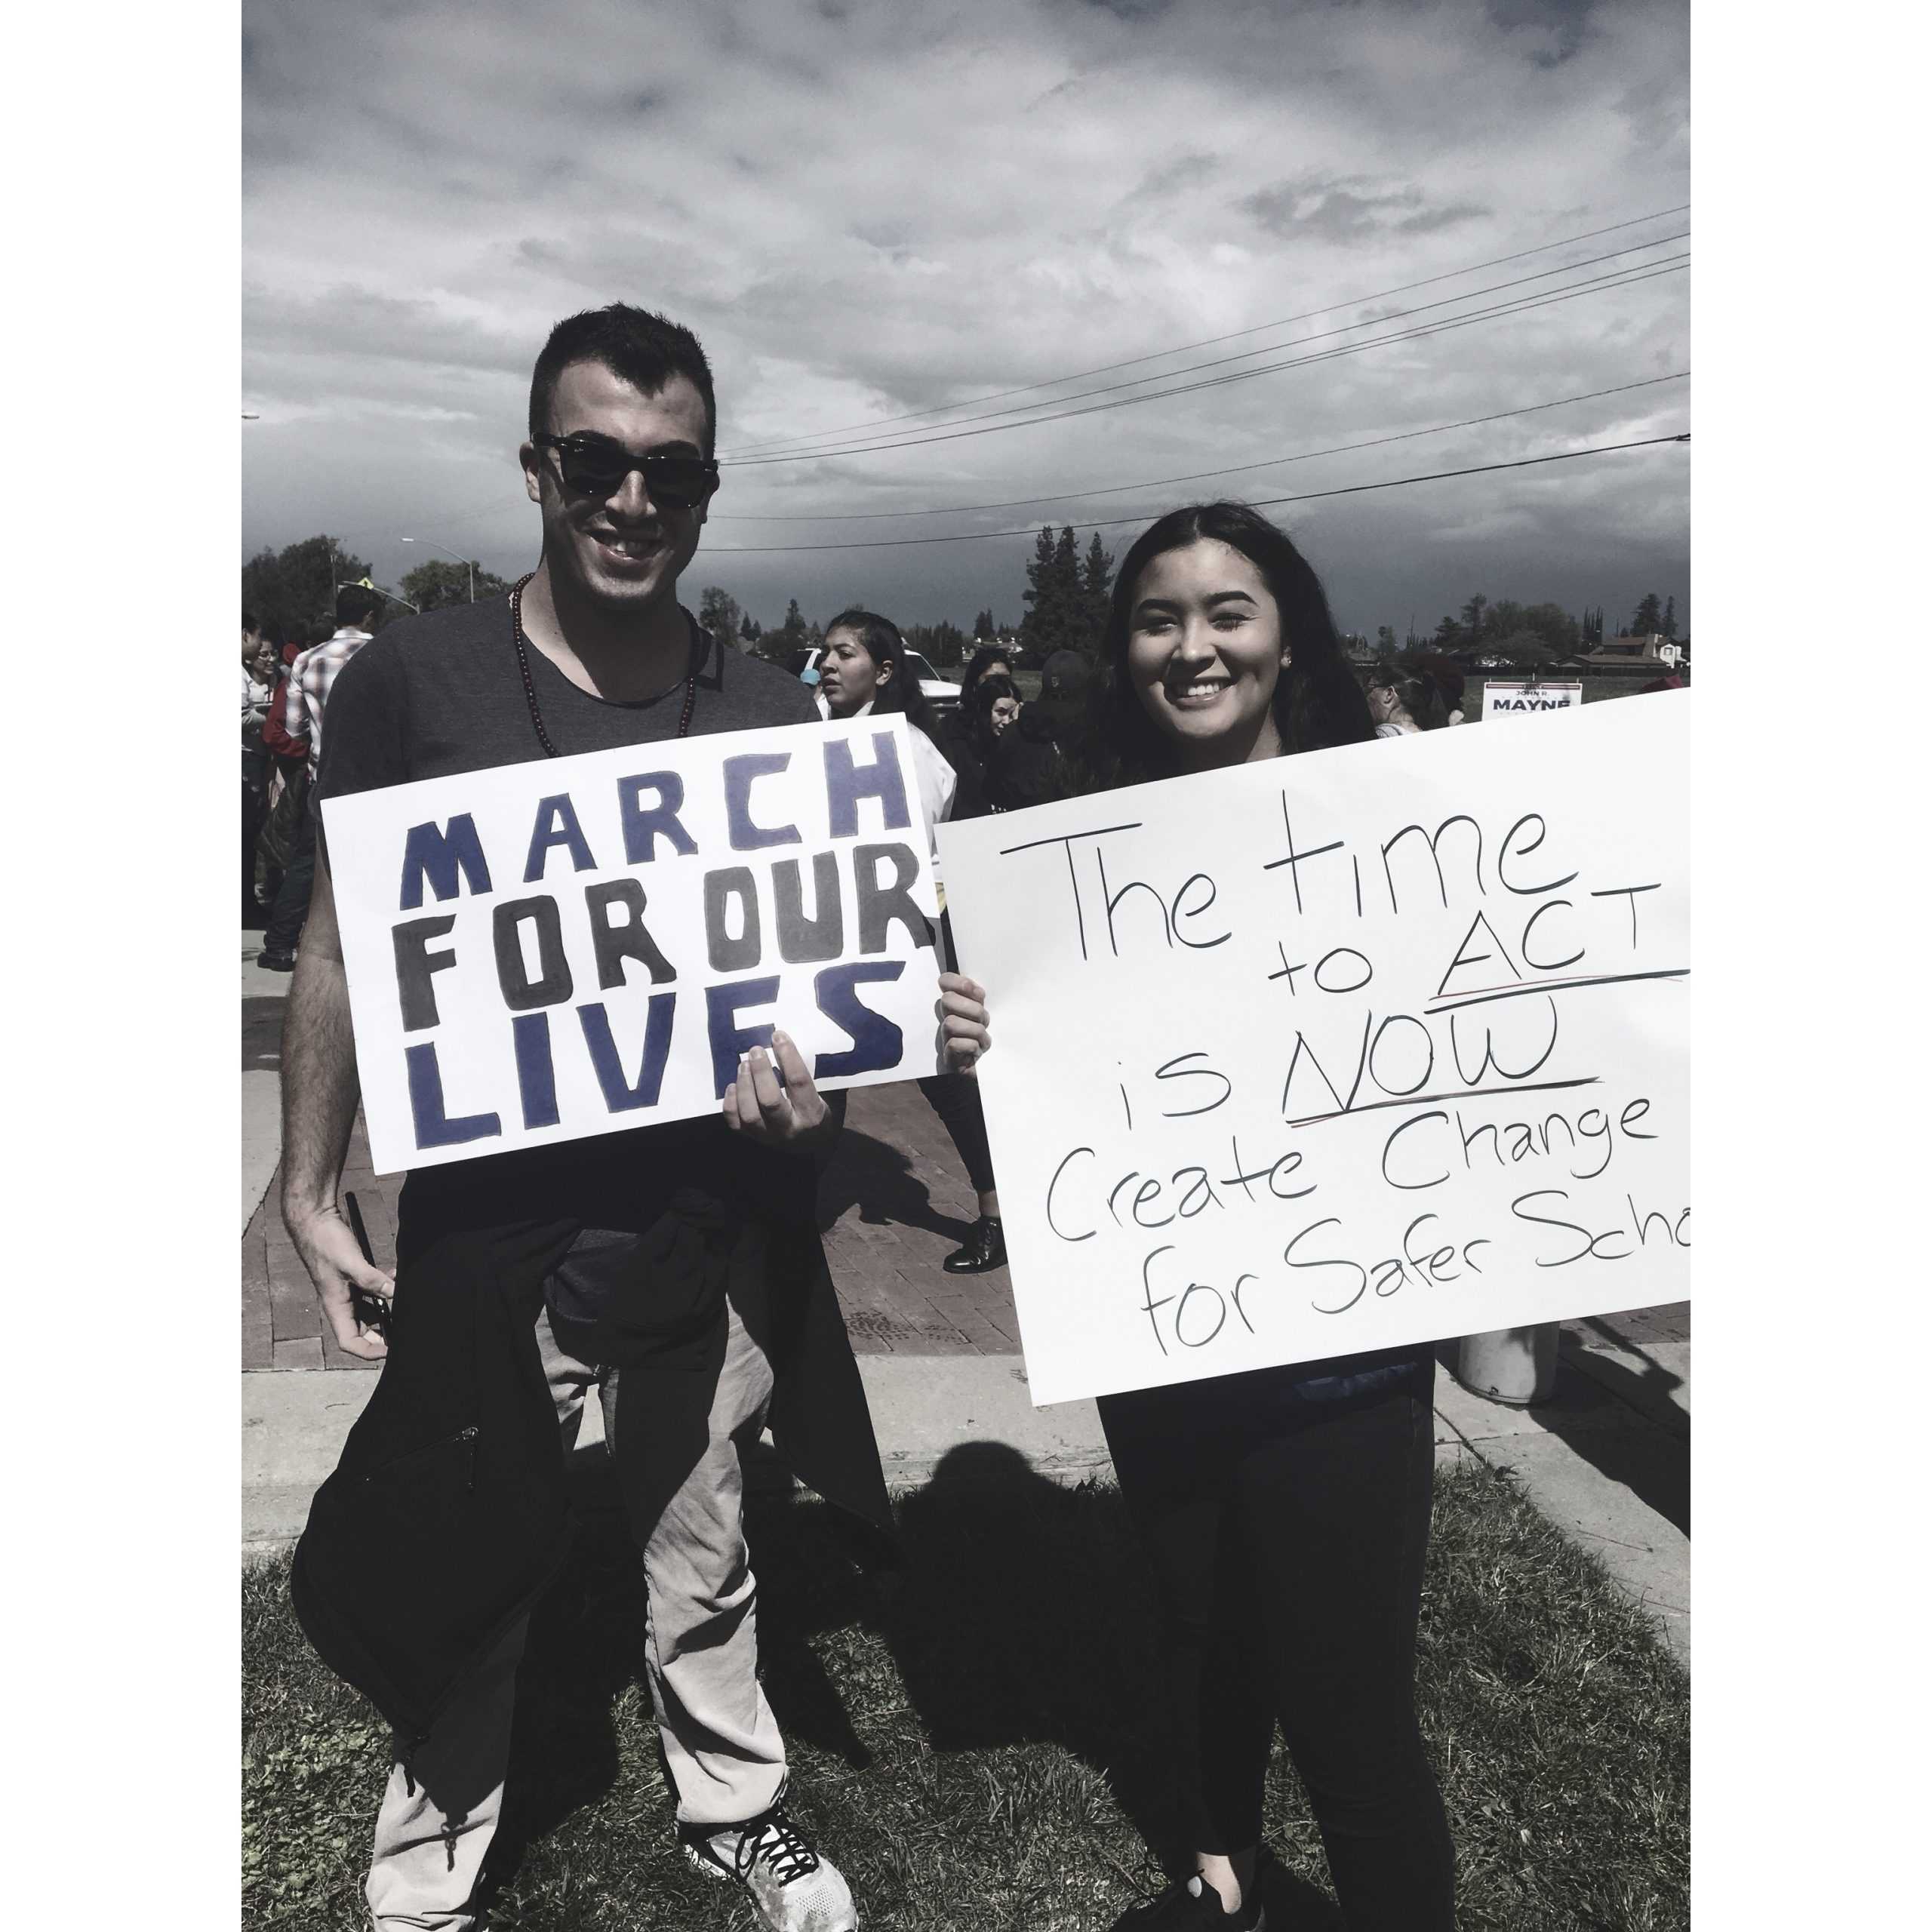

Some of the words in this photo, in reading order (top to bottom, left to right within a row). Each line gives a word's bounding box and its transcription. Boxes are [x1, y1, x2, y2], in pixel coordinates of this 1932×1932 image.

[400, 732, 911, 911] MARCH
[1000, 823, 1232, 961] The
[1263, 789, 1579, 917] time
[392, 878, 678, 1032] FOR
[704, 842, 937, 973] OUR
[1268, 941, 1373, 996] to
[1438, 883, 1662, 995] ACT
[404, 961, 906, 1151] LIVES
[1118, 1052, 1232, 1130] is
[1281, 996, 1558, 1113] NOW
[1047, 1136, 1318, 1242] Create
[1383, 1099, 1659, 1190] Change
[1140, 1246, 1260, 1356] for
[1284, 1214, 1491, 1315] Safer
